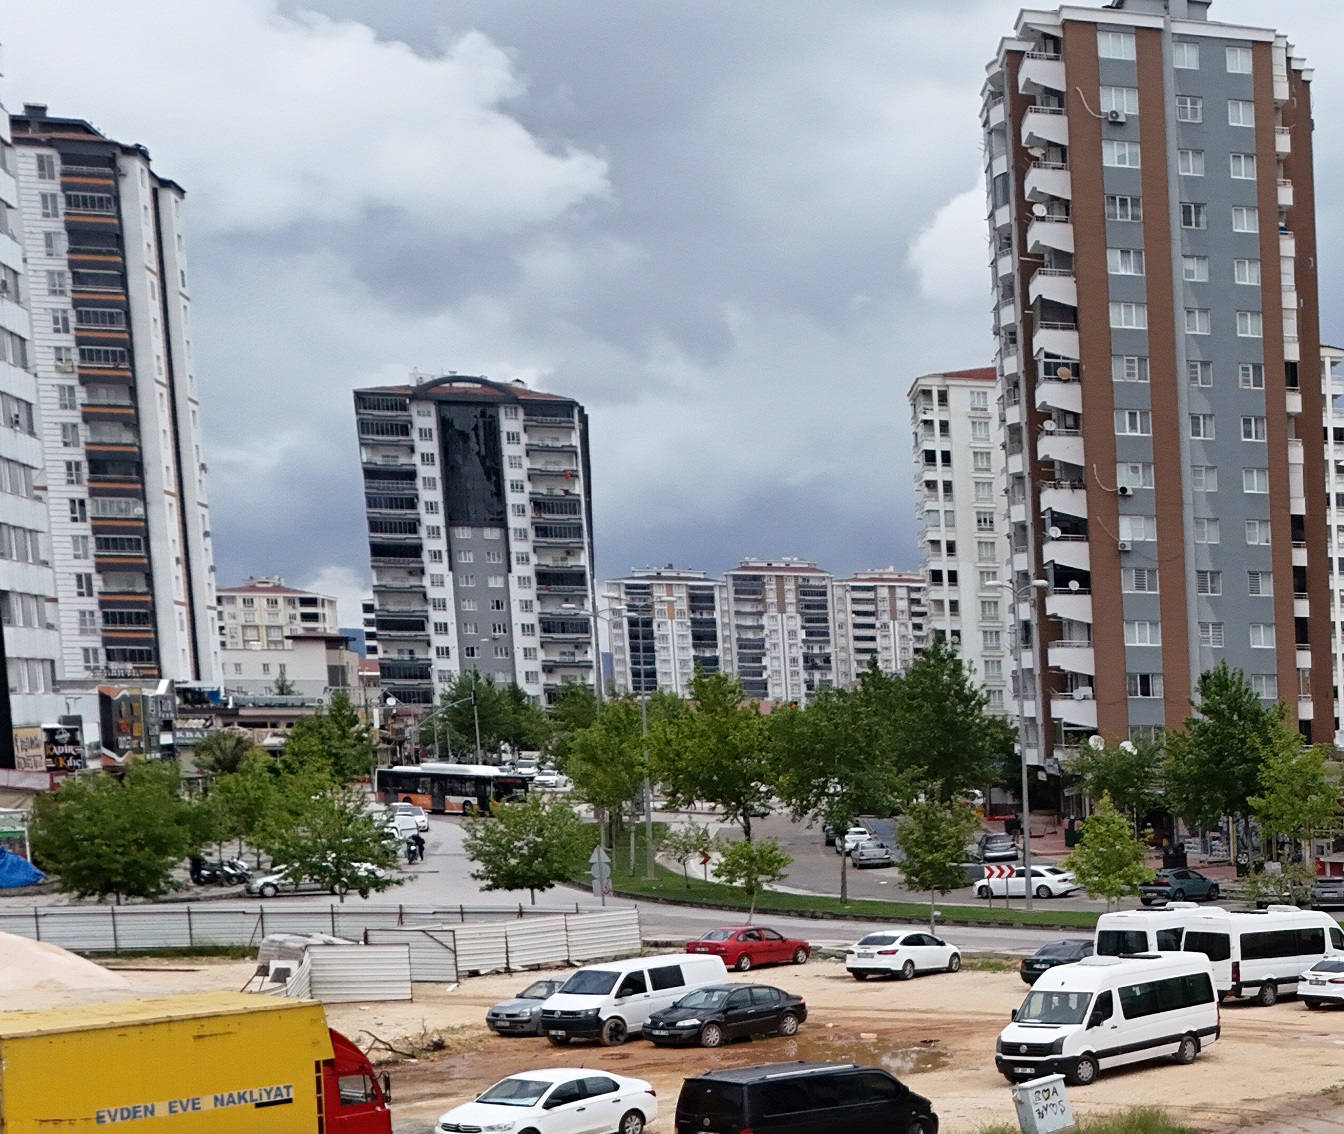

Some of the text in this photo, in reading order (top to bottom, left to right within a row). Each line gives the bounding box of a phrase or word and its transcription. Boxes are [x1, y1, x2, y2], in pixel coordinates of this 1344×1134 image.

[95, 1084, 294, 1124] EVDEN EVE NAKLİYAT
